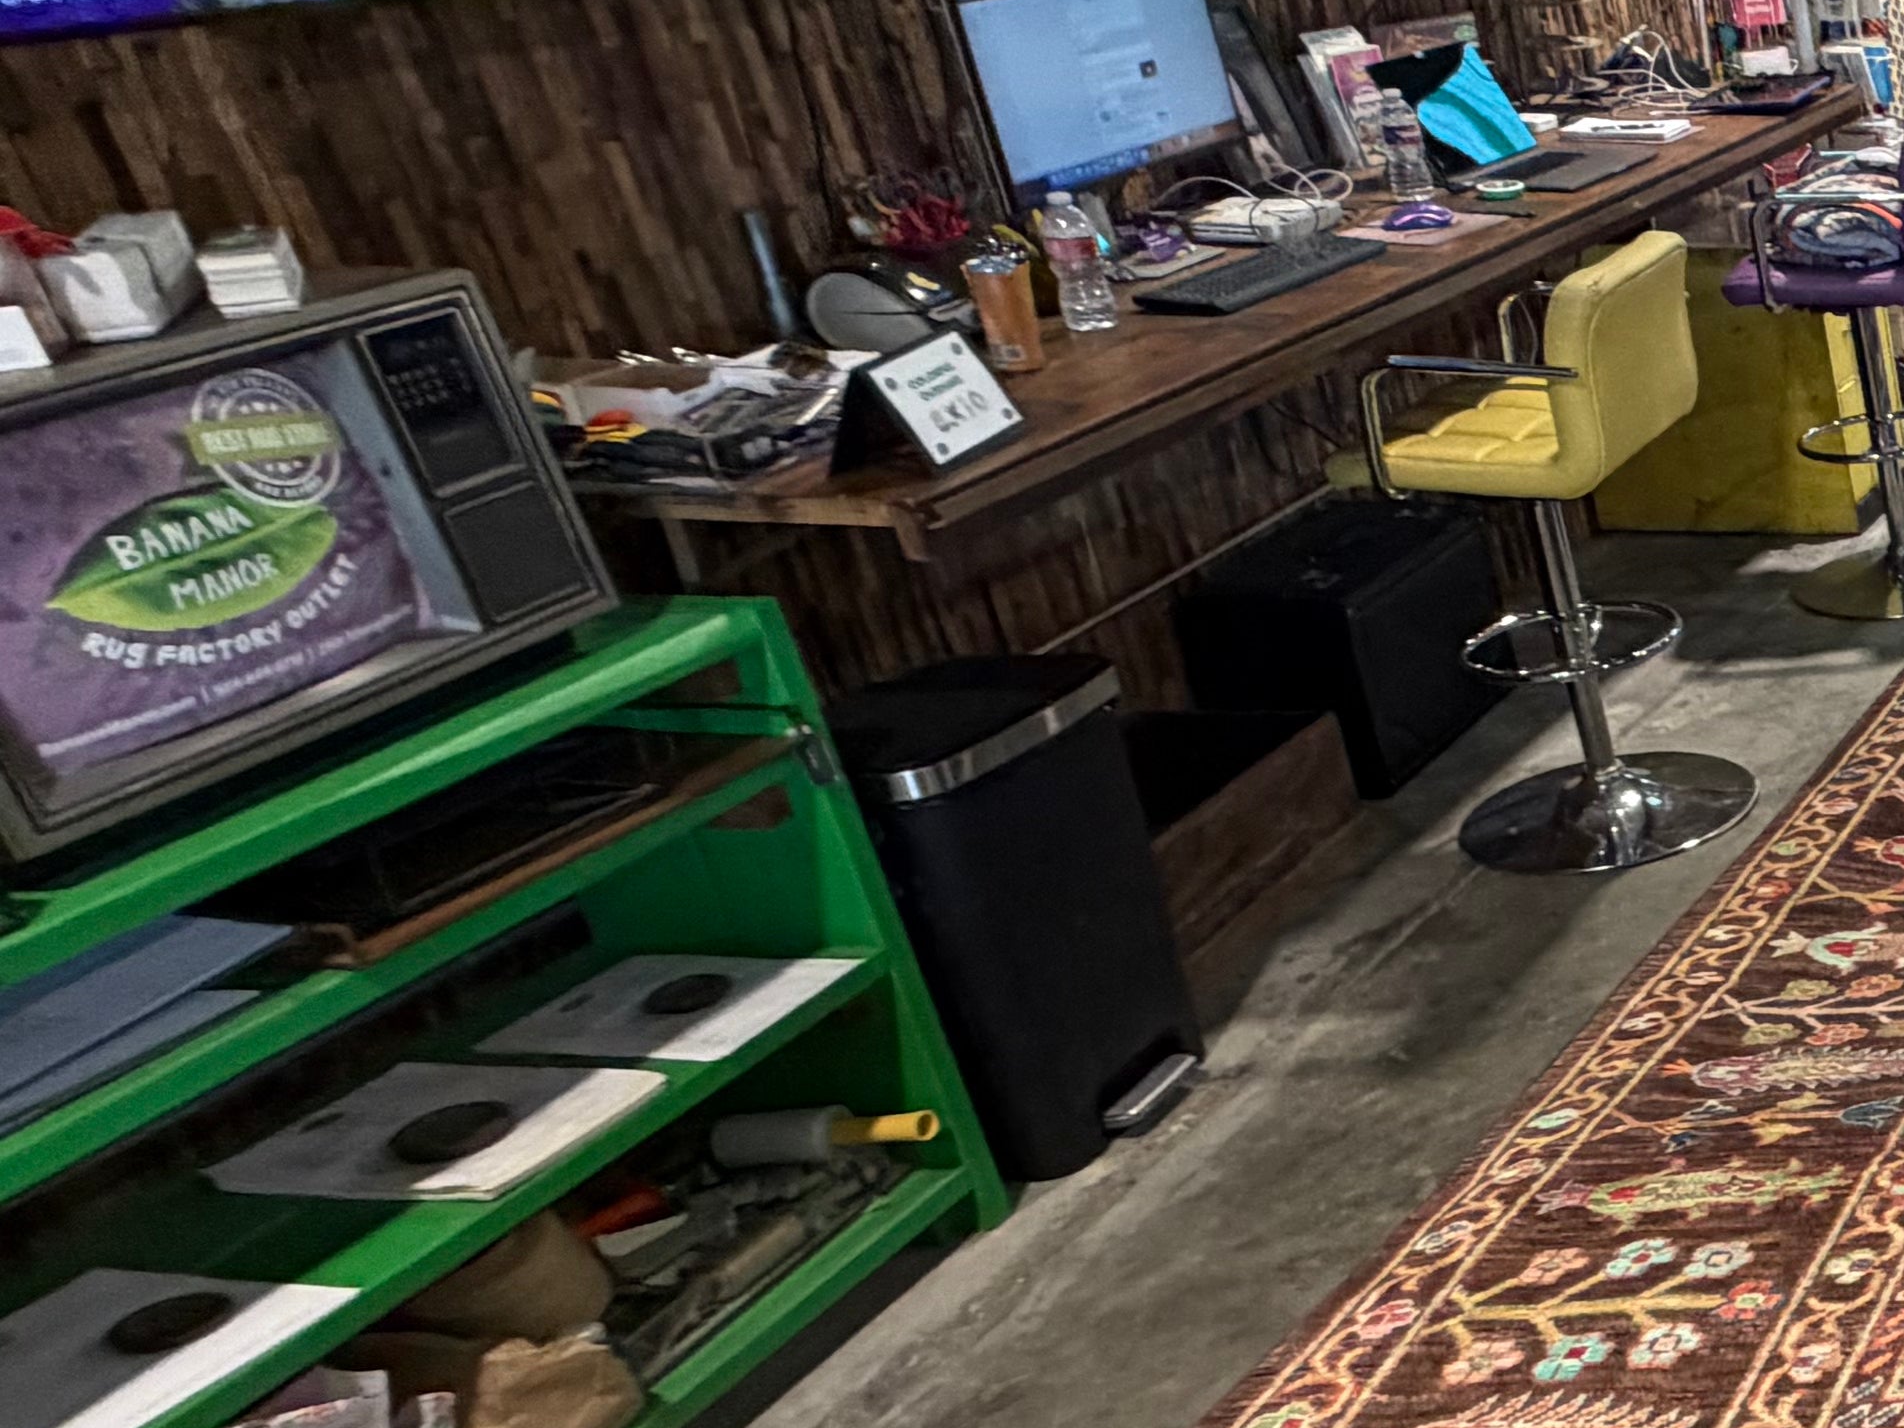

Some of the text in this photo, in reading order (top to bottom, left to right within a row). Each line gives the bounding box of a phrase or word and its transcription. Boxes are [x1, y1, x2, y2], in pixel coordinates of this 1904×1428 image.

[106, 505, 253, 571] BANANA
[81, 632, 149, 669] RUG
[155, 620, 284, 667] FACTORY
[285, 553, 359, 629] OUTLET
[168, 553, 279, 610] MANOR
